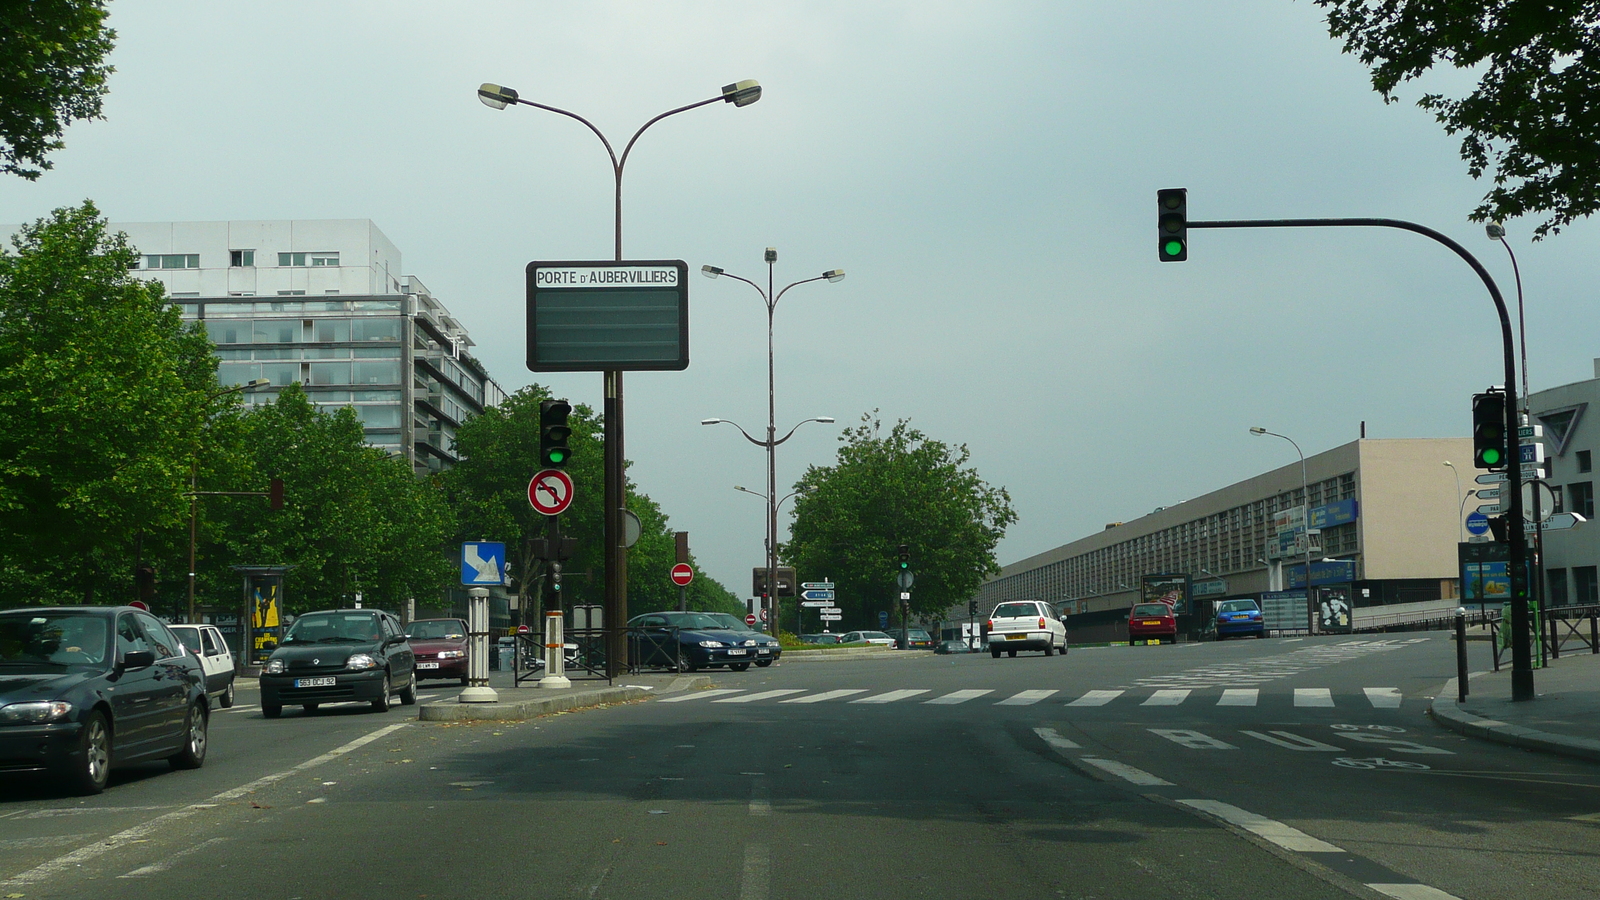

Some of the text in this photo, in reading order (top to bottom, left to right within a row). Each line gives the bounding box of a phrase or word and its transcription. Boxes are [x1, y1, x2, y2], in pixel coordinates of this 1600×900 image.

[537, 270, 677, 284] PORTE D'AUBERVILLIERS
[1146, 728, 1457, 755] BUS
